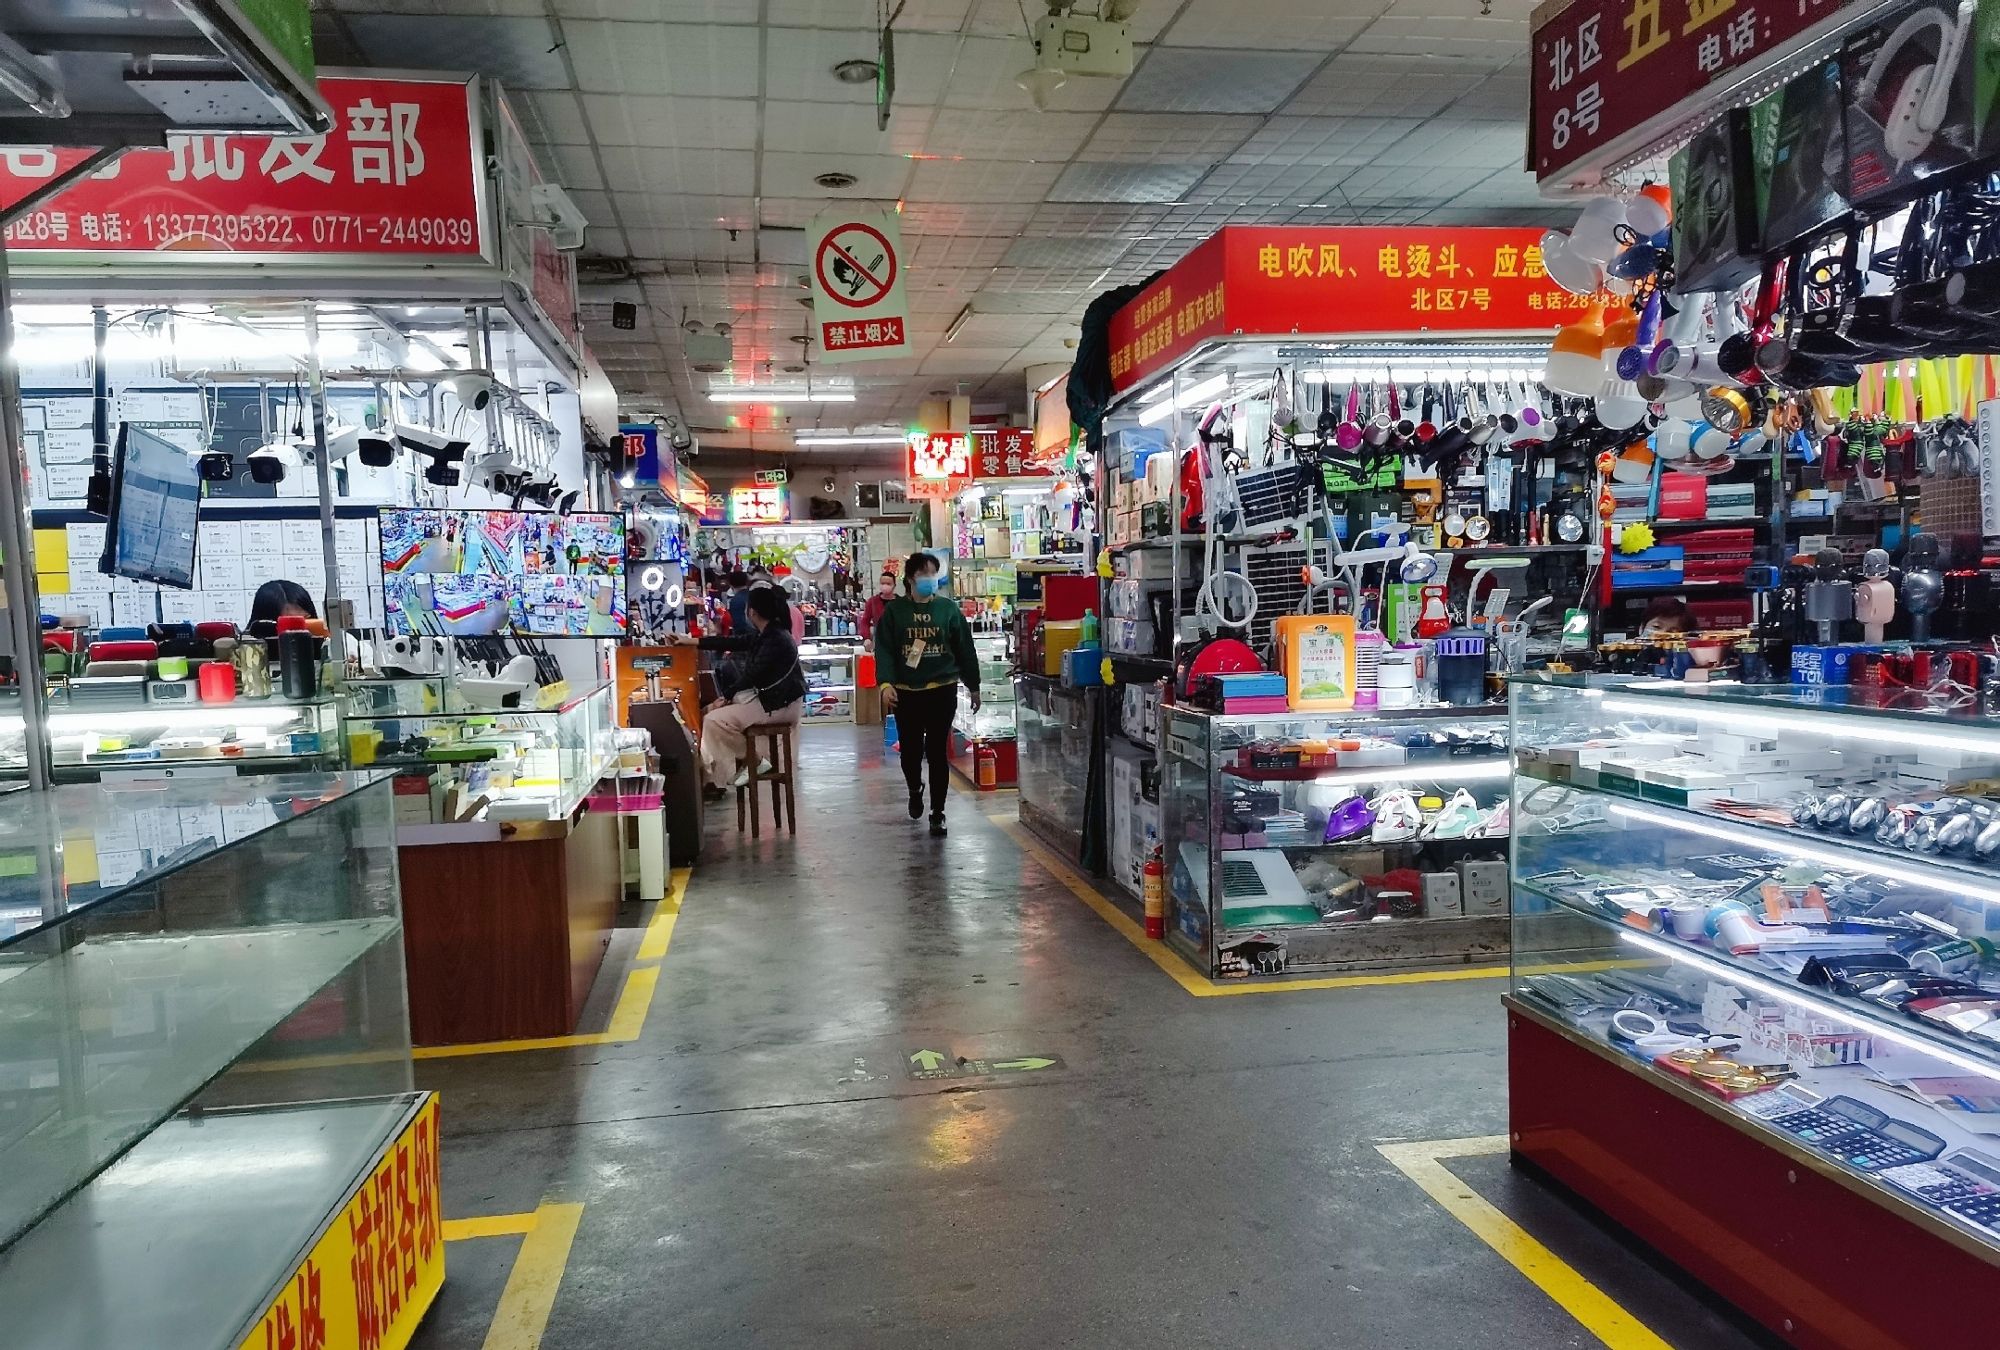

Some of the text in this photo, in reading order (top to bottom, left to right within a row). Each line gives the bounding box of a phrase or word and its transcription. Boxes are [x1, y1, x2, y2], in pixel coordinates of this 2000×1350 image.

[1549, 12, 1603, 91] 北区
[1552, 81, 1604, 150] 8号
[1411, 287, 1492, 311] 北区7号
[829, 322, 899, 346] 禁止烟火
[981, 434, 1022, 454] 批发
[983, 455, 1022, 475] 零售
[913, 612, 931, 623] NO
